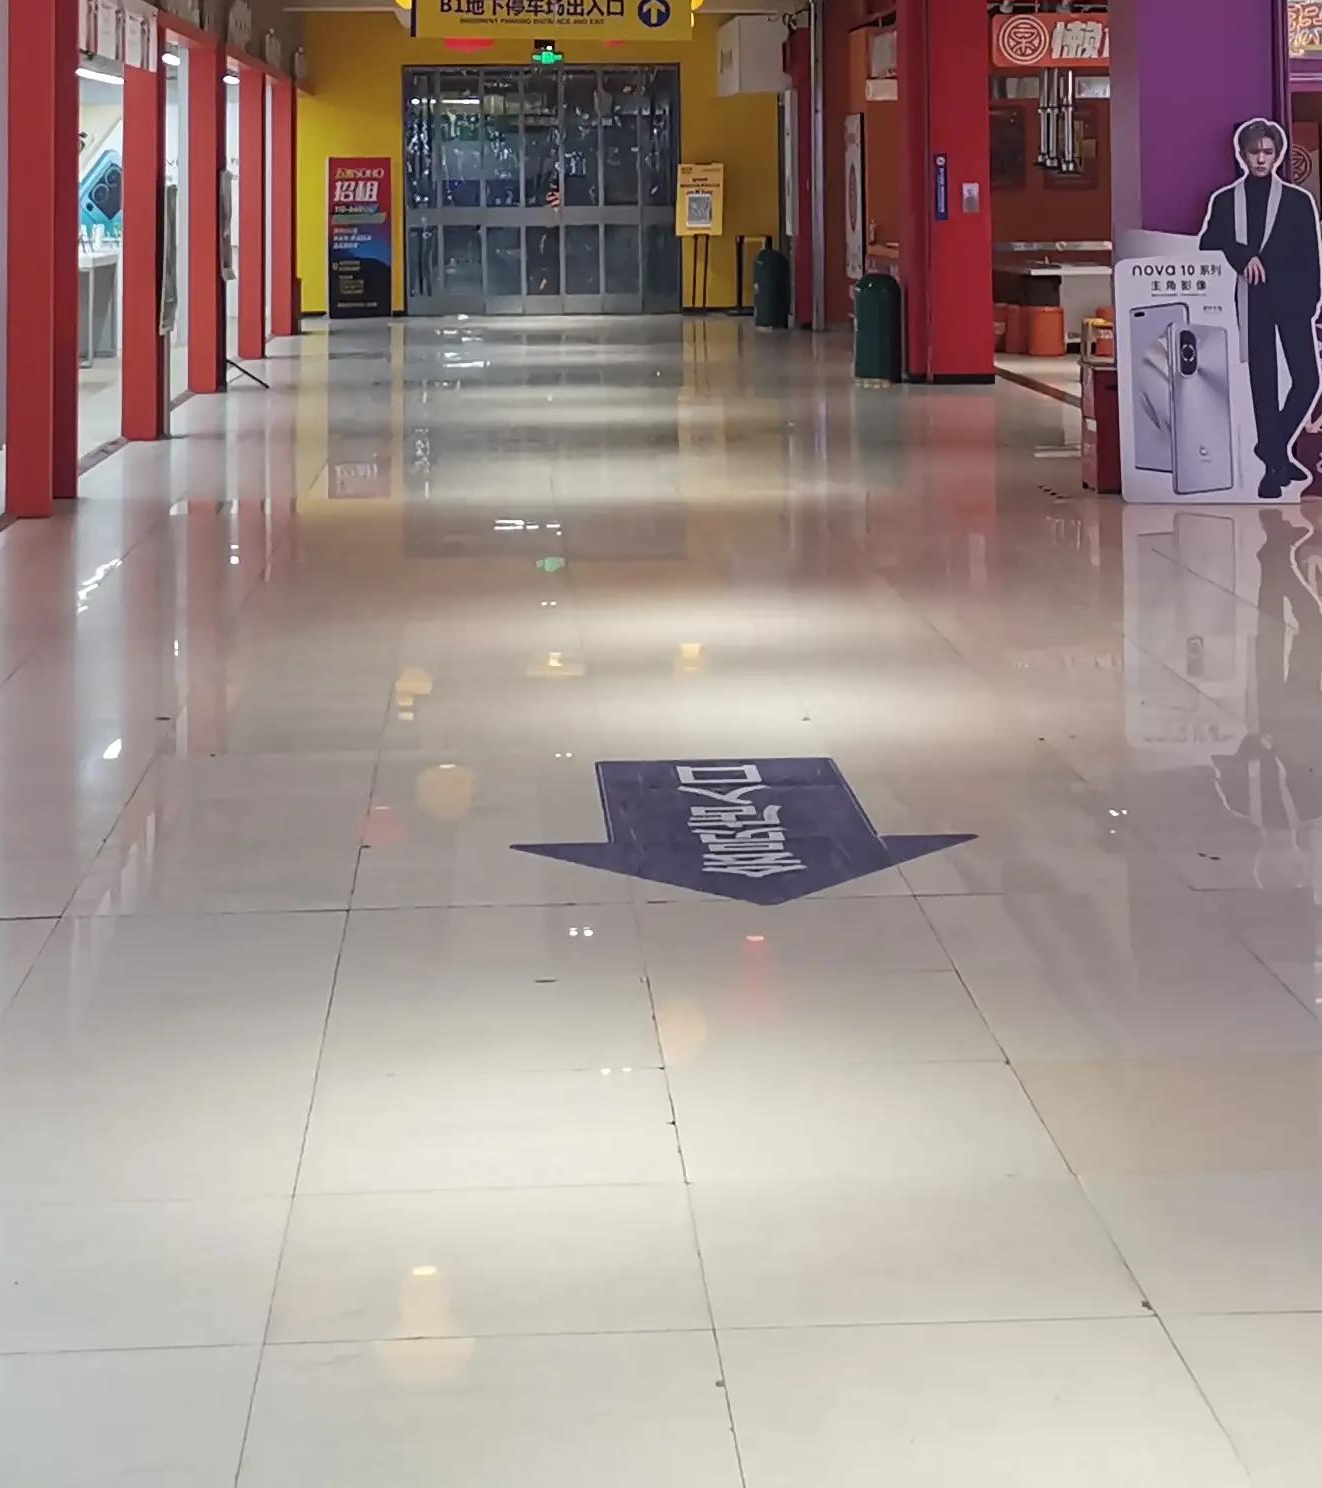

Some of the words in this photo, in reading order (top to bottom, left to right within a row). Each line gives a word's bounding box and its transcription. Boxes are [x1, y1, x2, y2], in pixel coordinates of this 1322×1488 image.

[1051, 21, 1110, 59] 懒
[334, 181, 378, 201] 招租
[1132, 265, 1176, 276] nova
[1181, 265, 1195, 275] 10
[676, 764, 808, 878] 会员店入口
